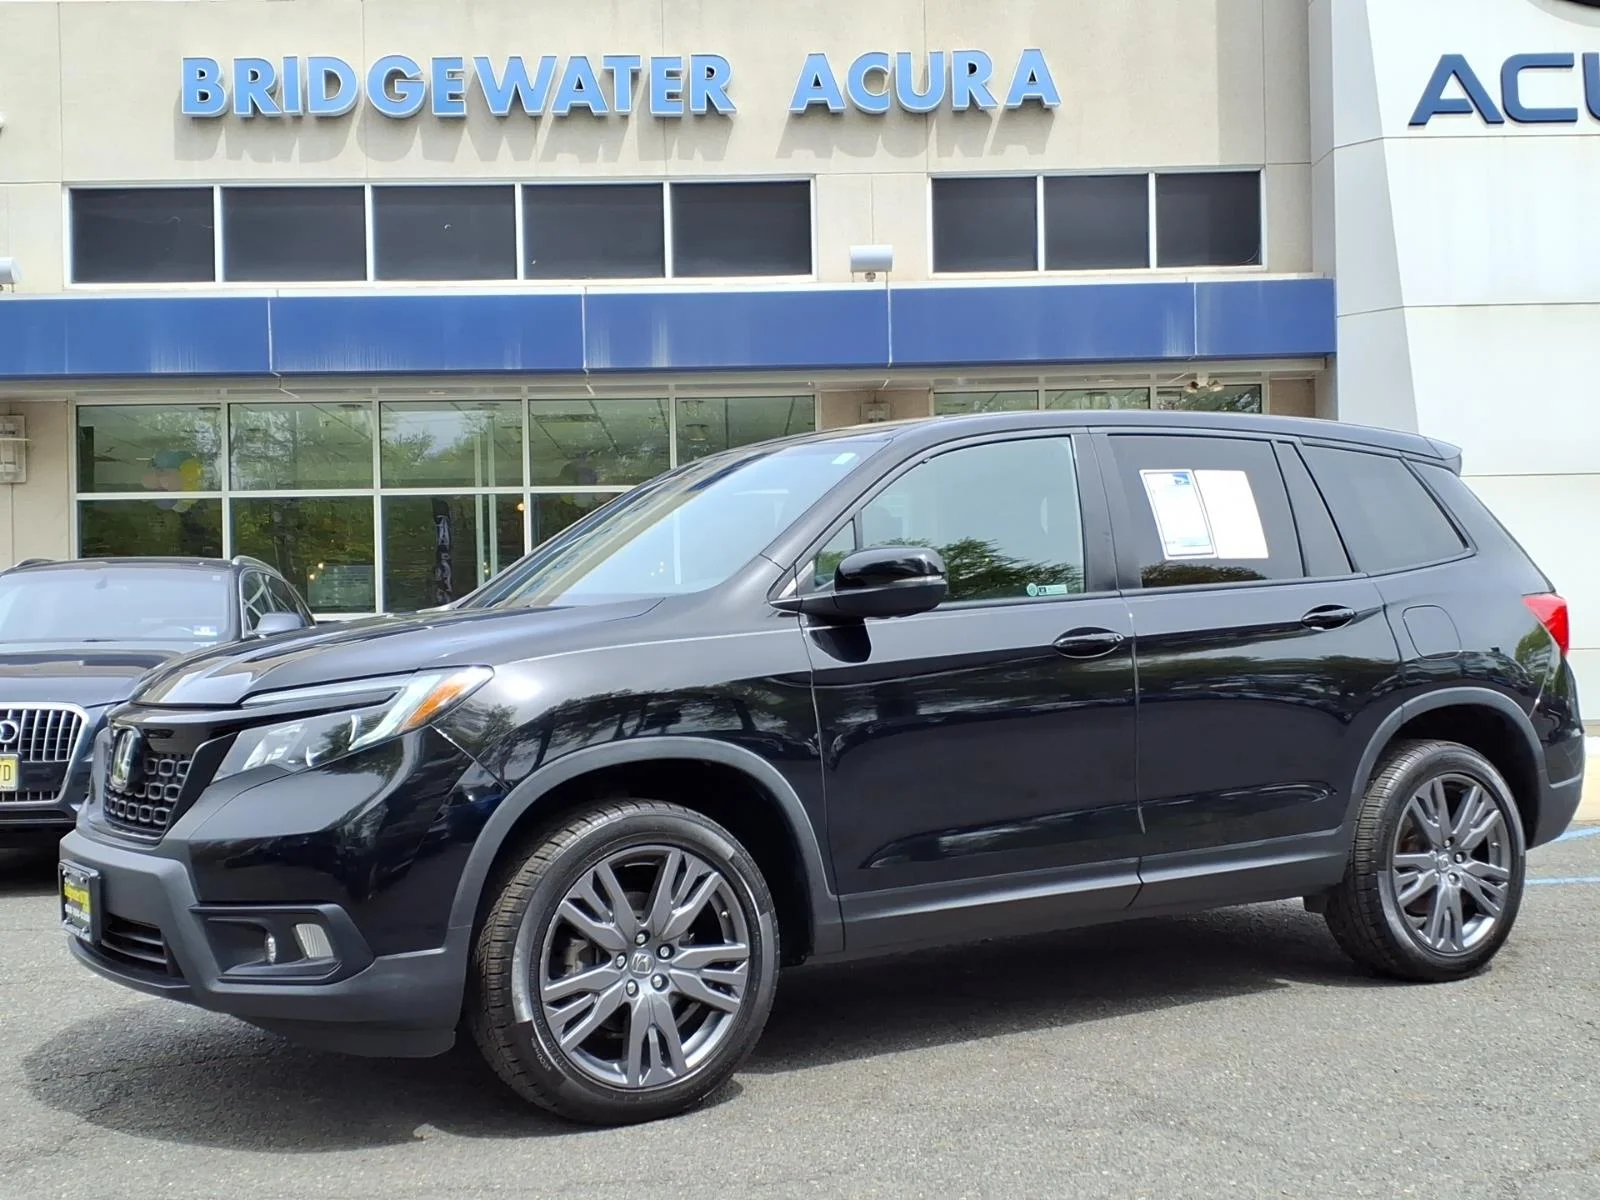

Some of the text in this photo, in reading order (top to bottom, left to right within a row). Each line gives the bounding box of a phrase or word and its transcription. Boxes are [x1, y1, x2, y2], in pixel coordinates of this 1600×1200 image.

[181, 48, 1061, 118] BRIDGEWATER ACURA
[1408, 52, 1600, 126] AC
